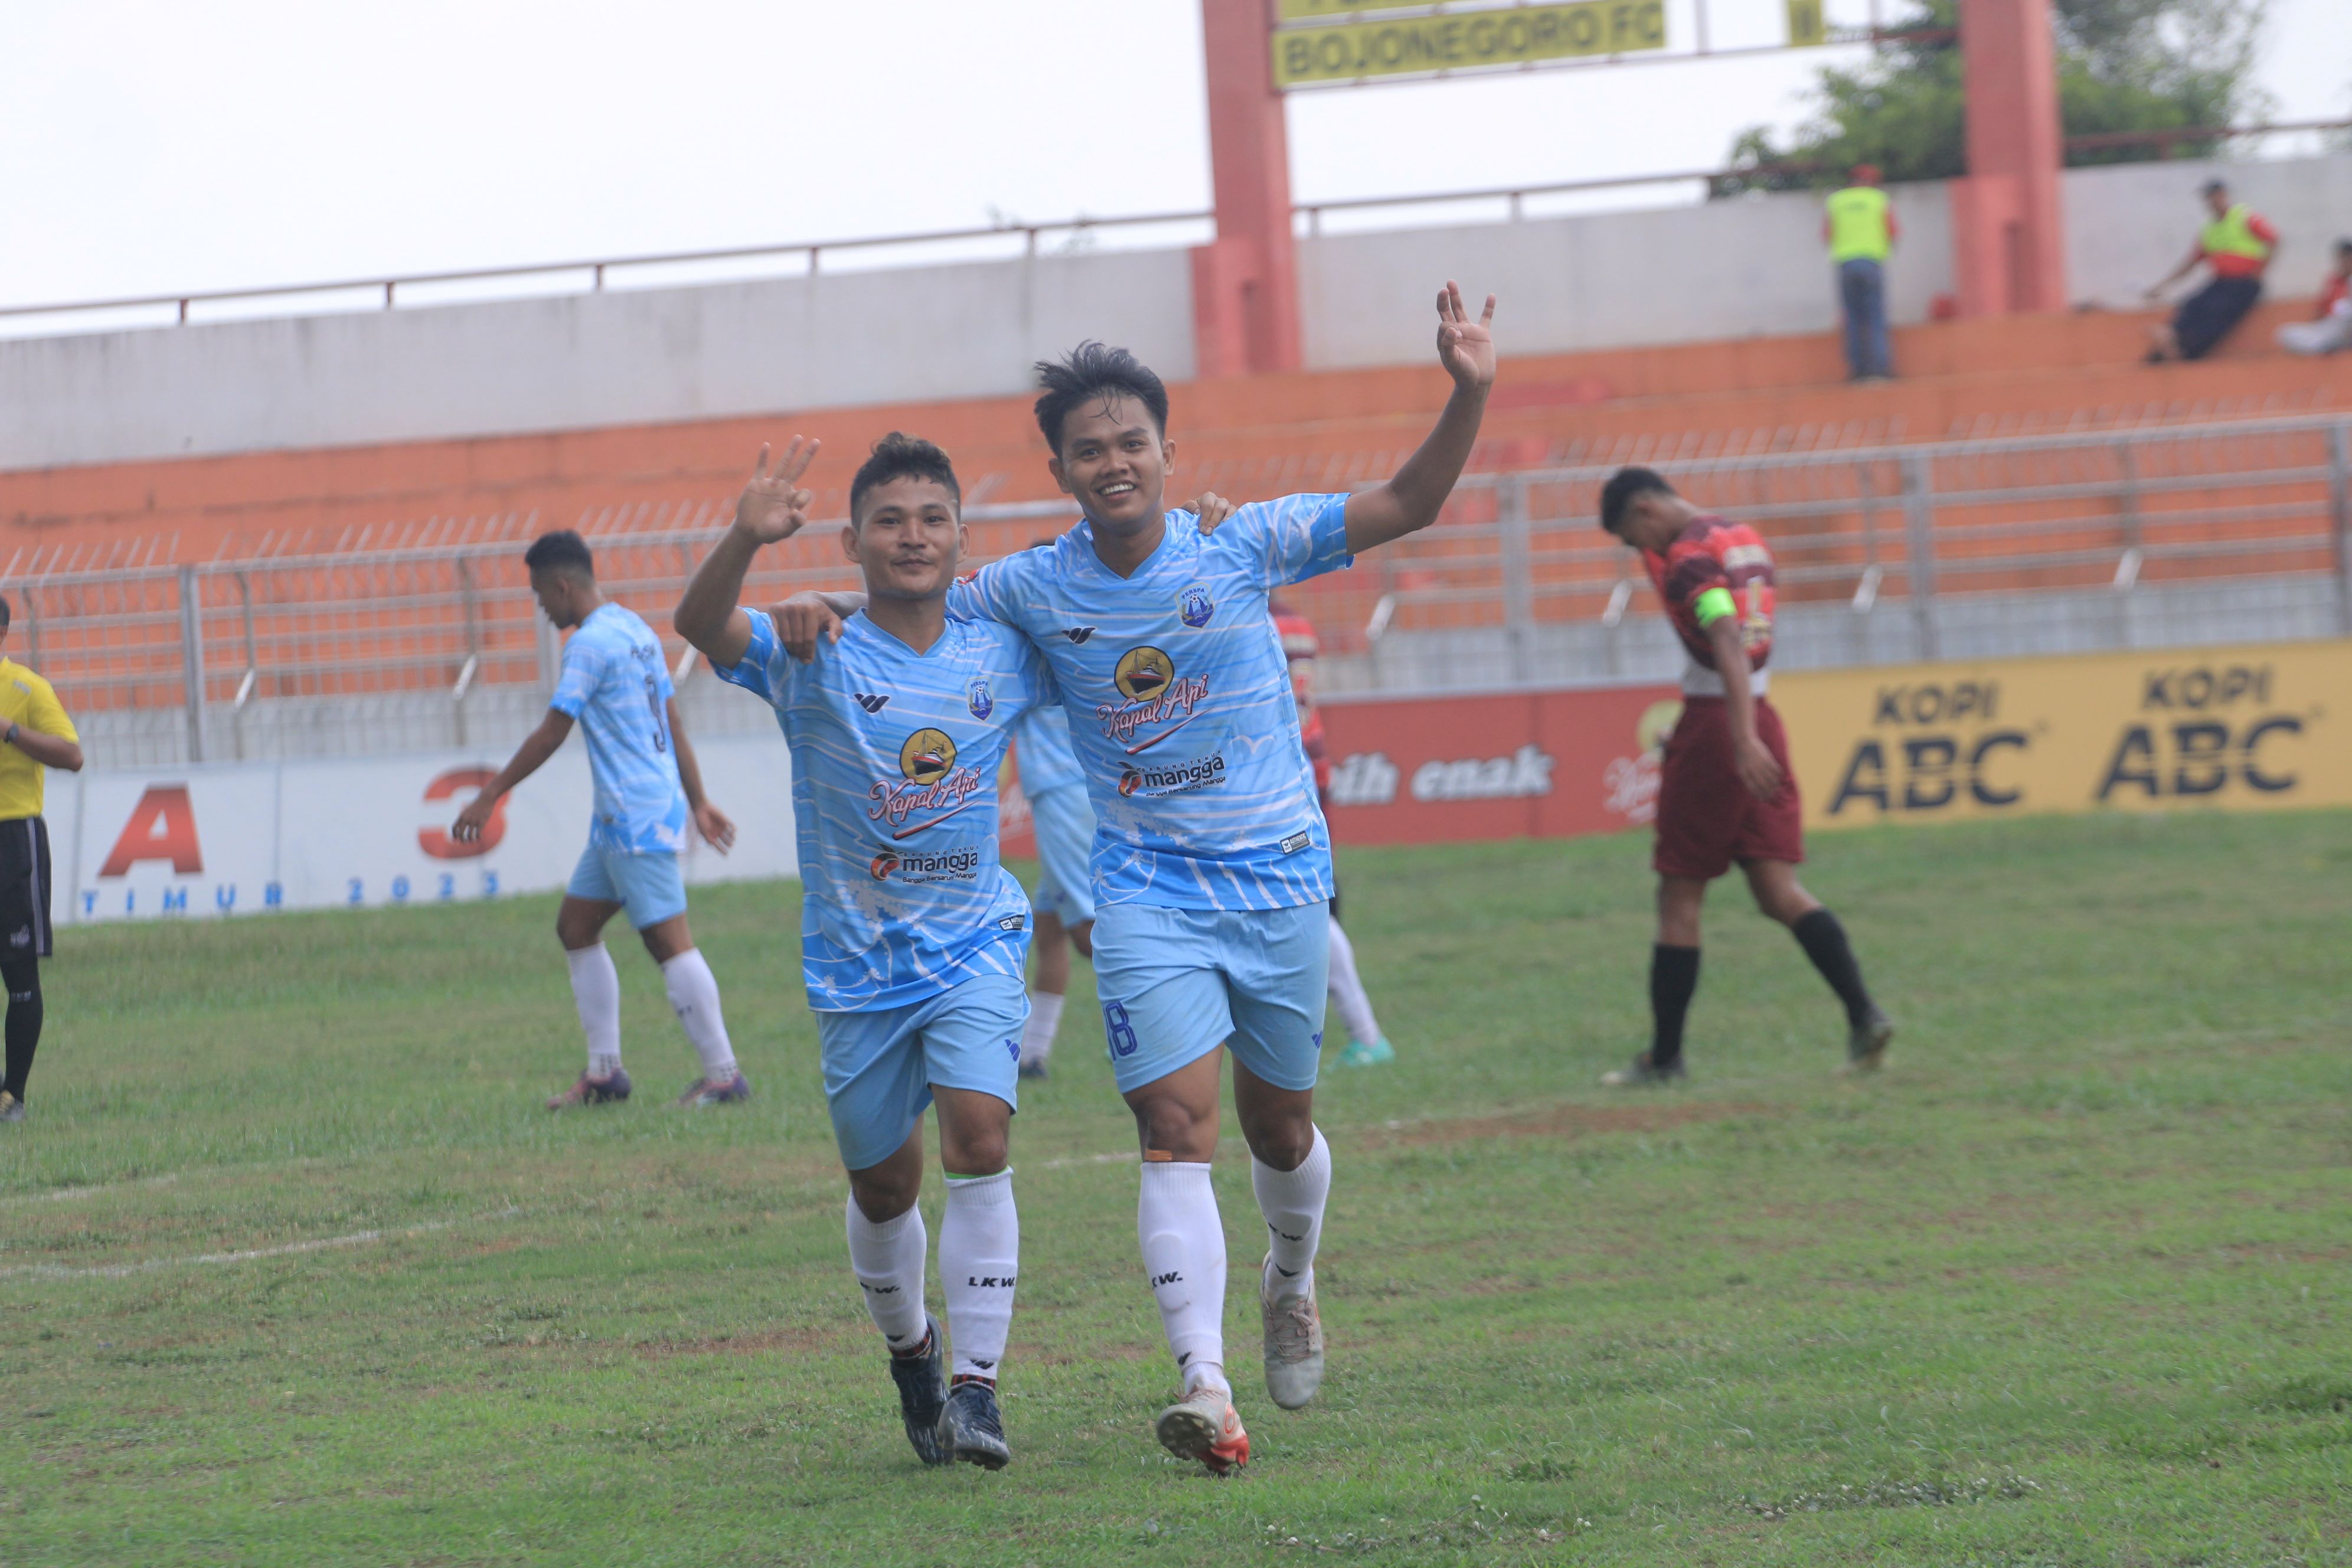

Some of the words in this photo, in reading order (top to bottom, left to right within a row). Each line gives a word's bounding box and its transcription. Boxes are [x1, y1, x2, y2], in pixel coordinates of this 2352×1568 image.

[1283, 7, 1600, 76] BOJONEGORO
[1612, 2, 1662, 41] FC
[1181, 587, 1205, 599] PERSPA
[970, 680, 988, 689] PERSPA
[1874, 681, 1999, 726] KOPI
[2141, 664, 2274, 710] KOPI
[1096, 693, 1164, 744] Kapal
[1164, 674, 1209, 720] Api
[1144, 756, 1225, 787] mangga
[1203, 776, 1226, 786] Mangga
[1410, 743, 1556, 803] enak
[1825, 732, 2028, 814] ABC
[2094, 717, 2302, 801] ABC
[418, 765, 512, 860] 3
[868, 778, 941, 827] Kapal
[937, 766, 981, 807] Api
[903, 852, 978, 874] mangga
[81, 881, 283, 914] TIMUR
[348, 868, 499, 905] 2023
